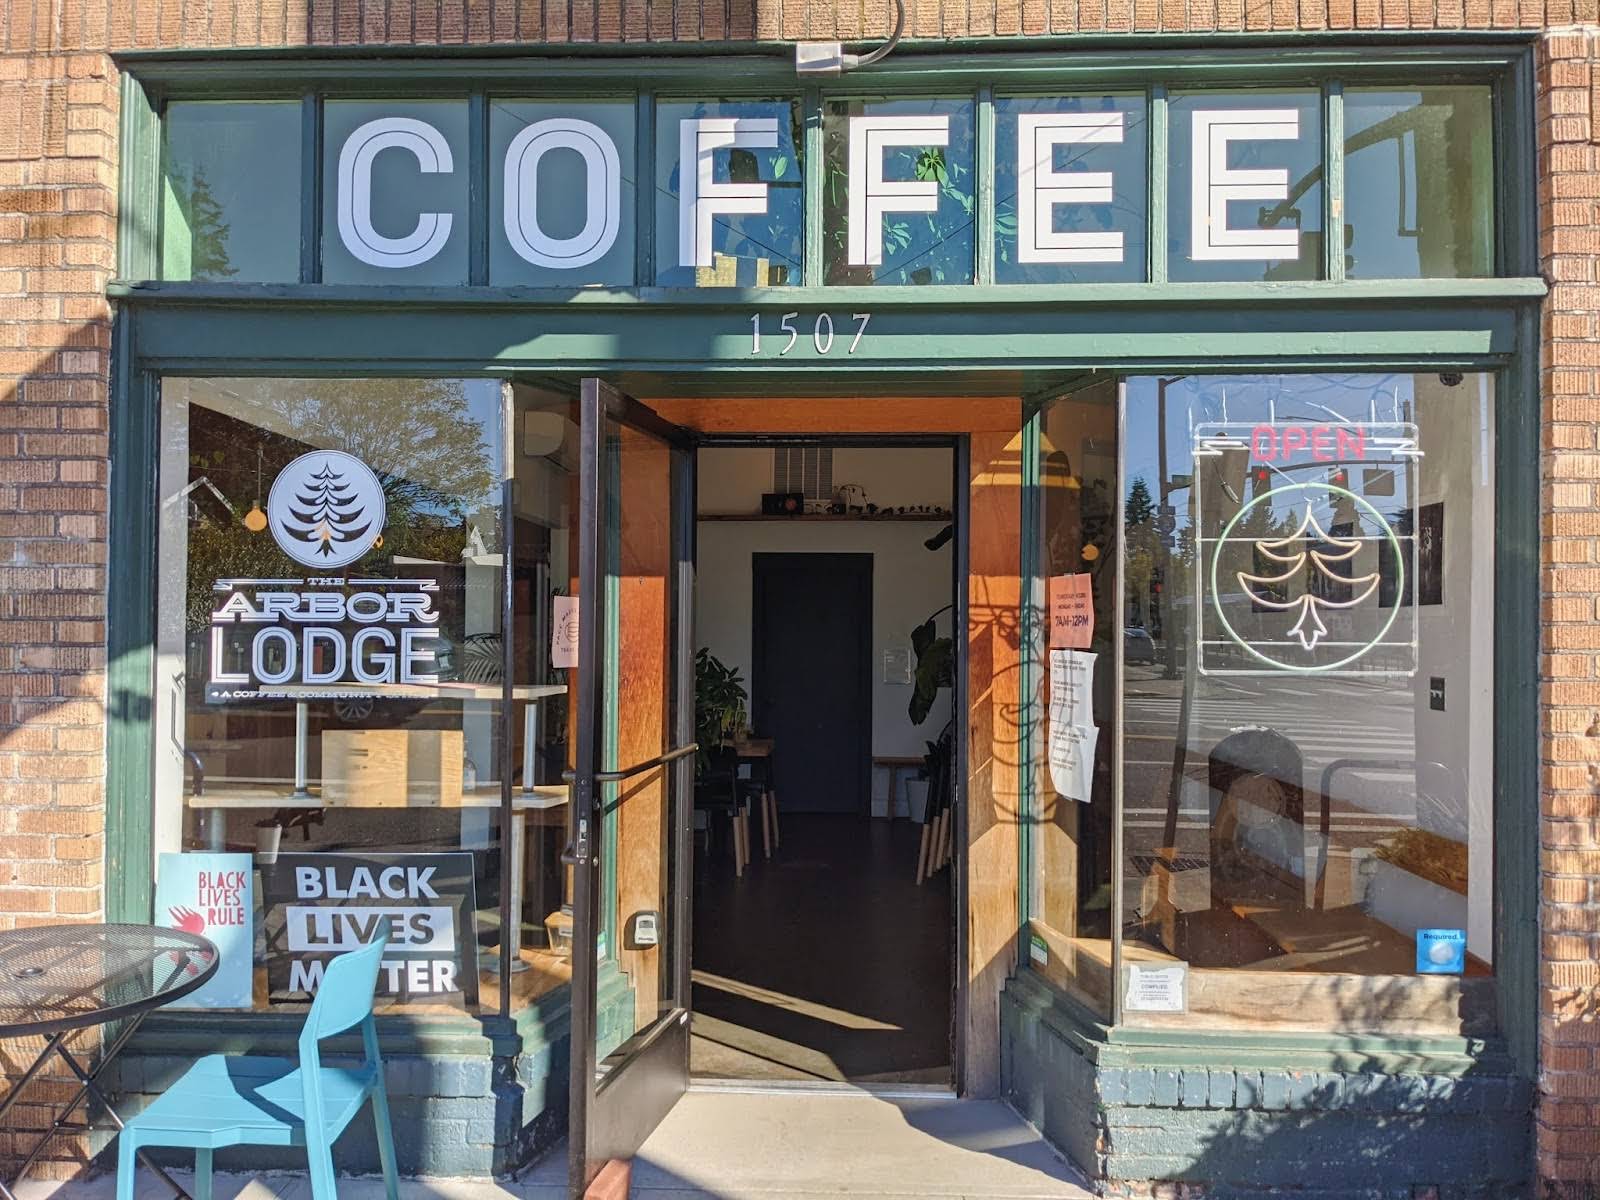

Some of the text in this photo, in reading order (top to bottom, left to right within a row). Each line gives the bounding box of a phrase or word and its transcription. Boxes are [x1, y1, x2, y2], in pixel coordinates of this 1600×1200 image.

[337, 109, 1300, 271] COFFEE
[750, 312, 871, 355] 1507
[1252, 424, 1366, 462] OPEN
[307, 577, 345, 586] THE
[212, 592, 440, 623] ARBOR
[211, 626, 440, 684] LODGE
[199, 871, 246, 889] BLACK
[295, 866, 440, 899] BLACK
[199, 889, 241, 907] LIVES
[208, 907, 245, 925] RULE
[305, 913, 434, 945] LIVES
[289, 960, 460, 993] MTER
